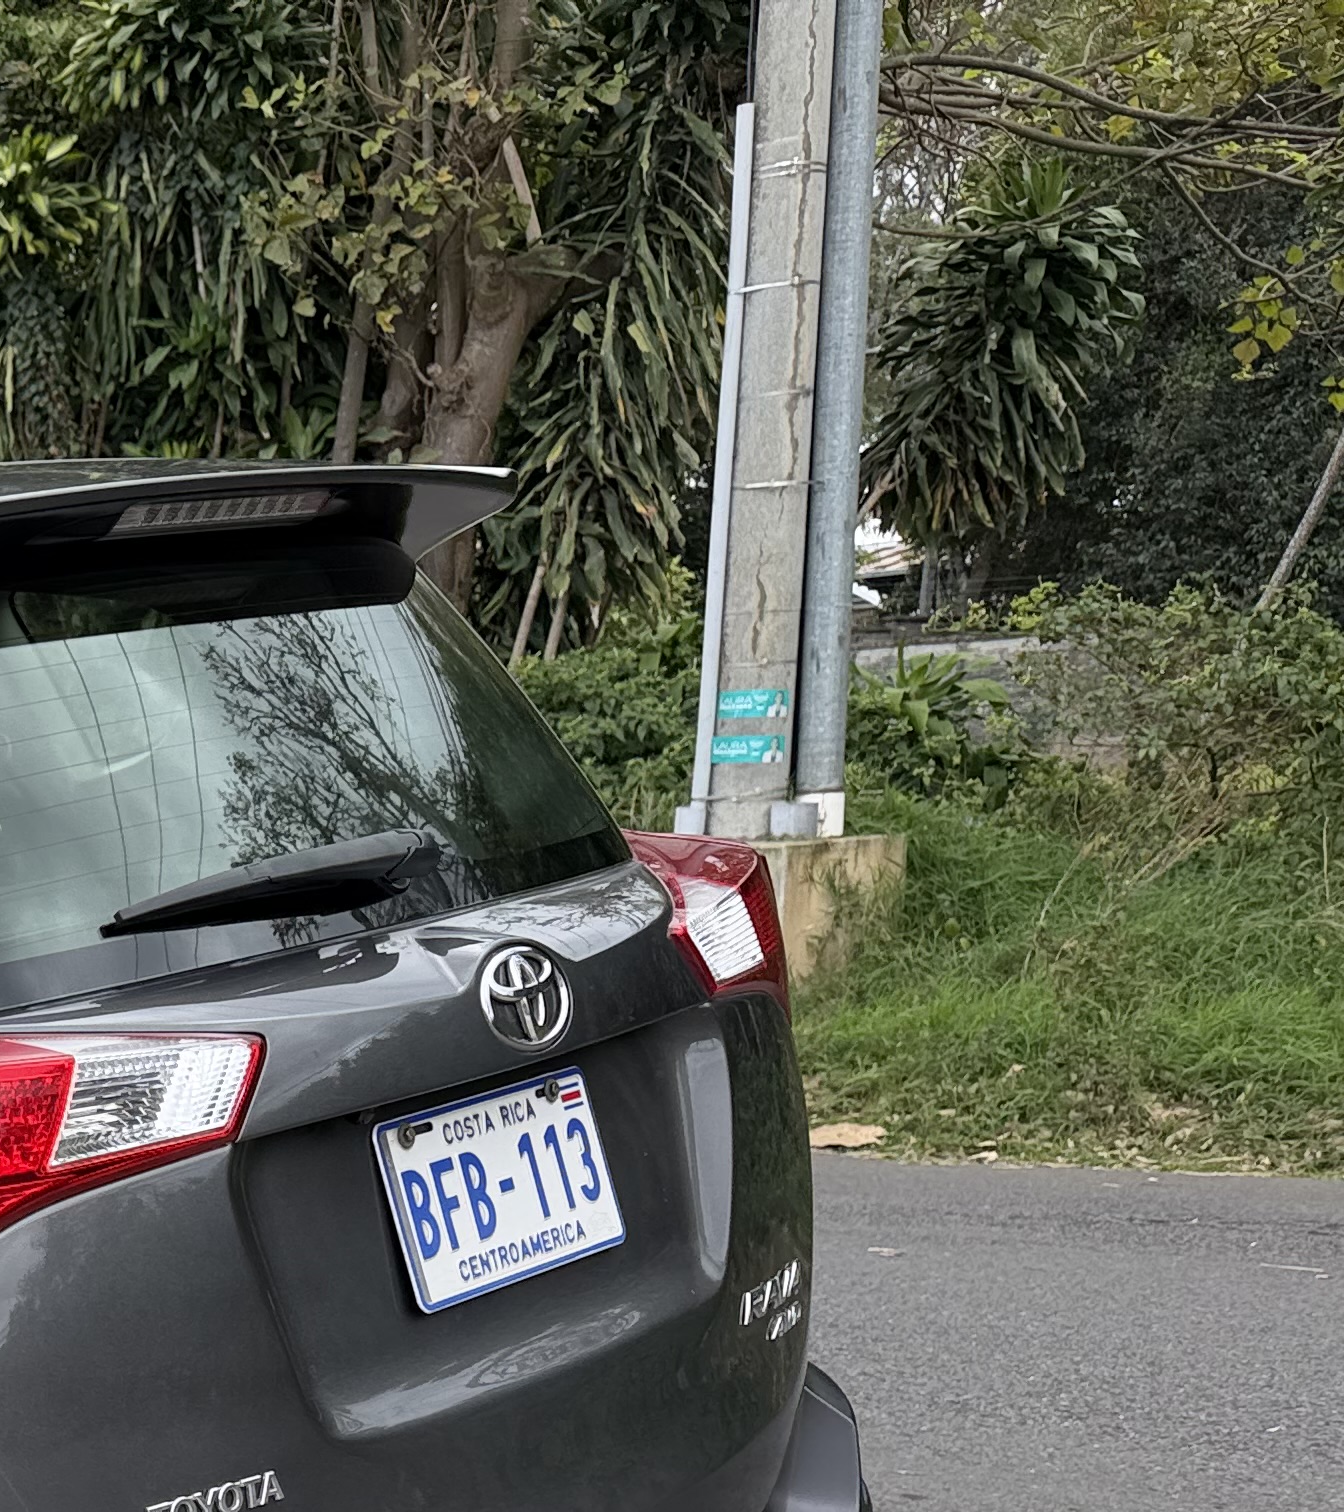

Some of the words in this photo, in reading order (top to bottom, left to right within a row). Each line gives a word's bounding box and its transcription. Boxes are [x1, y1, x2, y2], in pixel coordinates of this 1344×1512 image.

[442, 1110, 496, 1145] COSTA
[499, 1098, 537, 1129] RICA
[400, 1117, 602, 1261] BFB-113
[458, 1219, 587, 1283] CENTROAMERICA
